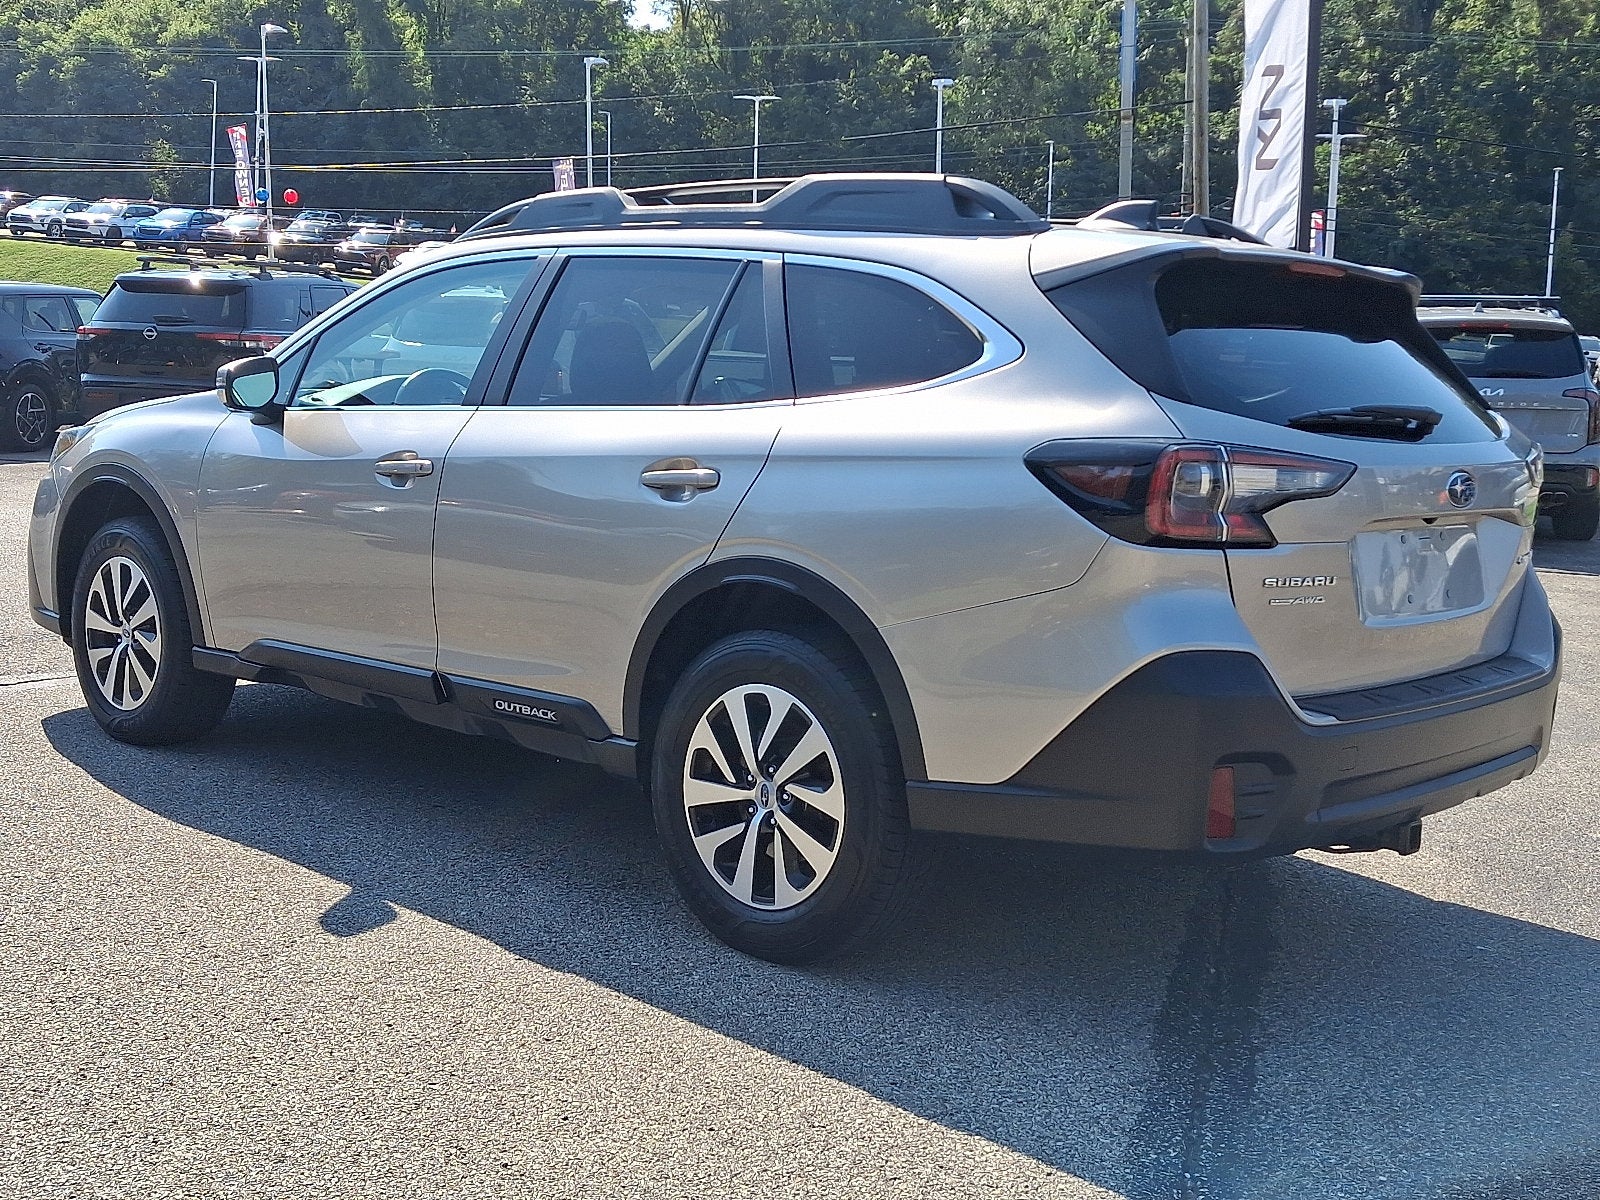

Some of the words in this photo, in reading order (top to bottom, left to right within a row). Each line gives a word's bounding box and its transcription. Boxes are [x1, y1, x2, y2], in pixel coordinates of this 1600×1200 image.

[1263, 576, 1337, 588] SUBARU
[1293, 595, 1326, 605] AWD
[495, 699, 558, 721] OUTBACK
